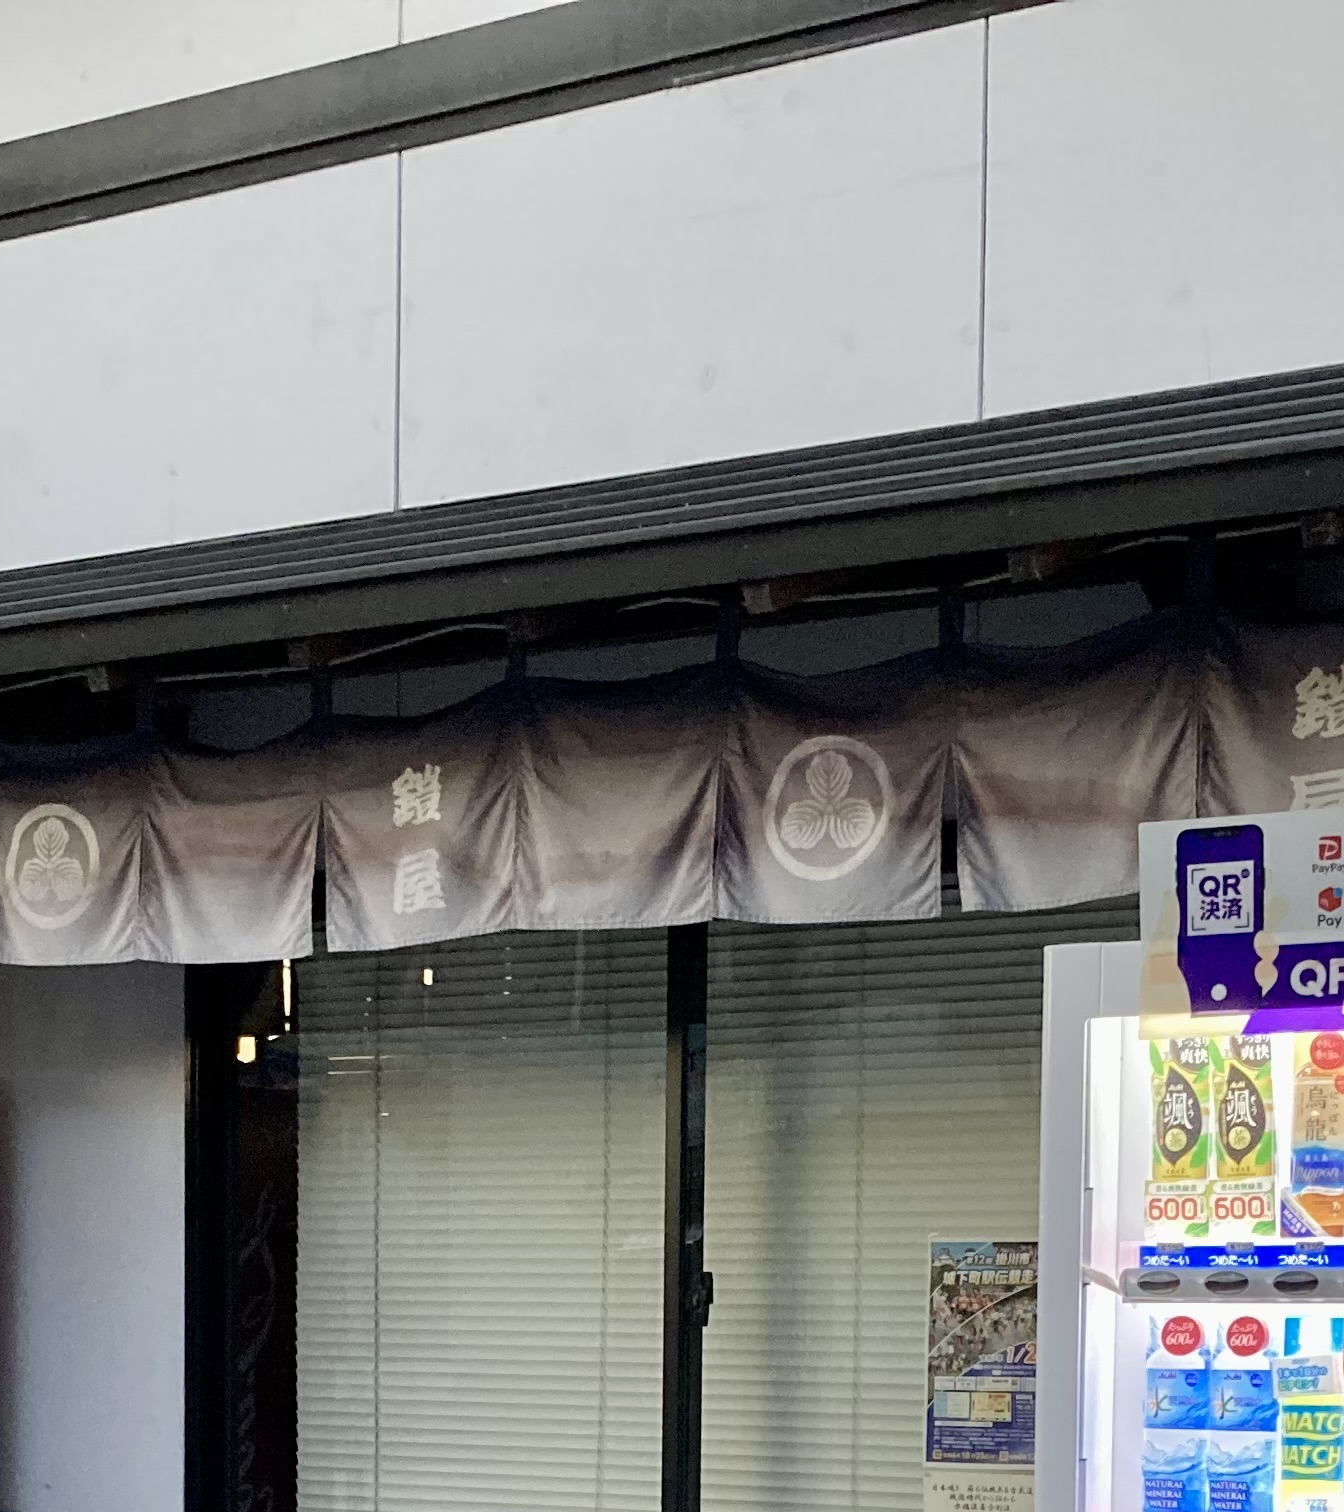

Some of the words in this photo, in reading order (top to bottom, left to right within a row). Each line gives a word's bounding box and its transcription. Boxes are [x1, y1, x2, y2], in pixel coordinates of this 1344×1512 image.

[392, 763, 446, 914] 鎧屋
[1199, 875, 1242, 897] QR
[1200, 897, 1243, 921] 決済
[1317, 914, 1343, 928] Pay
[1305, 1085, 1327, 1142] 烏龍
[1146, 1480, 1185, 1490] NATURAL
[1210, 1481, 1249, 1491] NATURAL
[1145, 1490, 1184, 1500] MINERAL
[1210, 1491, 1248, 1501] MINERAL
[1149, 1500, 1179, 1509] WATER
[1213, 1501, 1243, 1511] WATER
